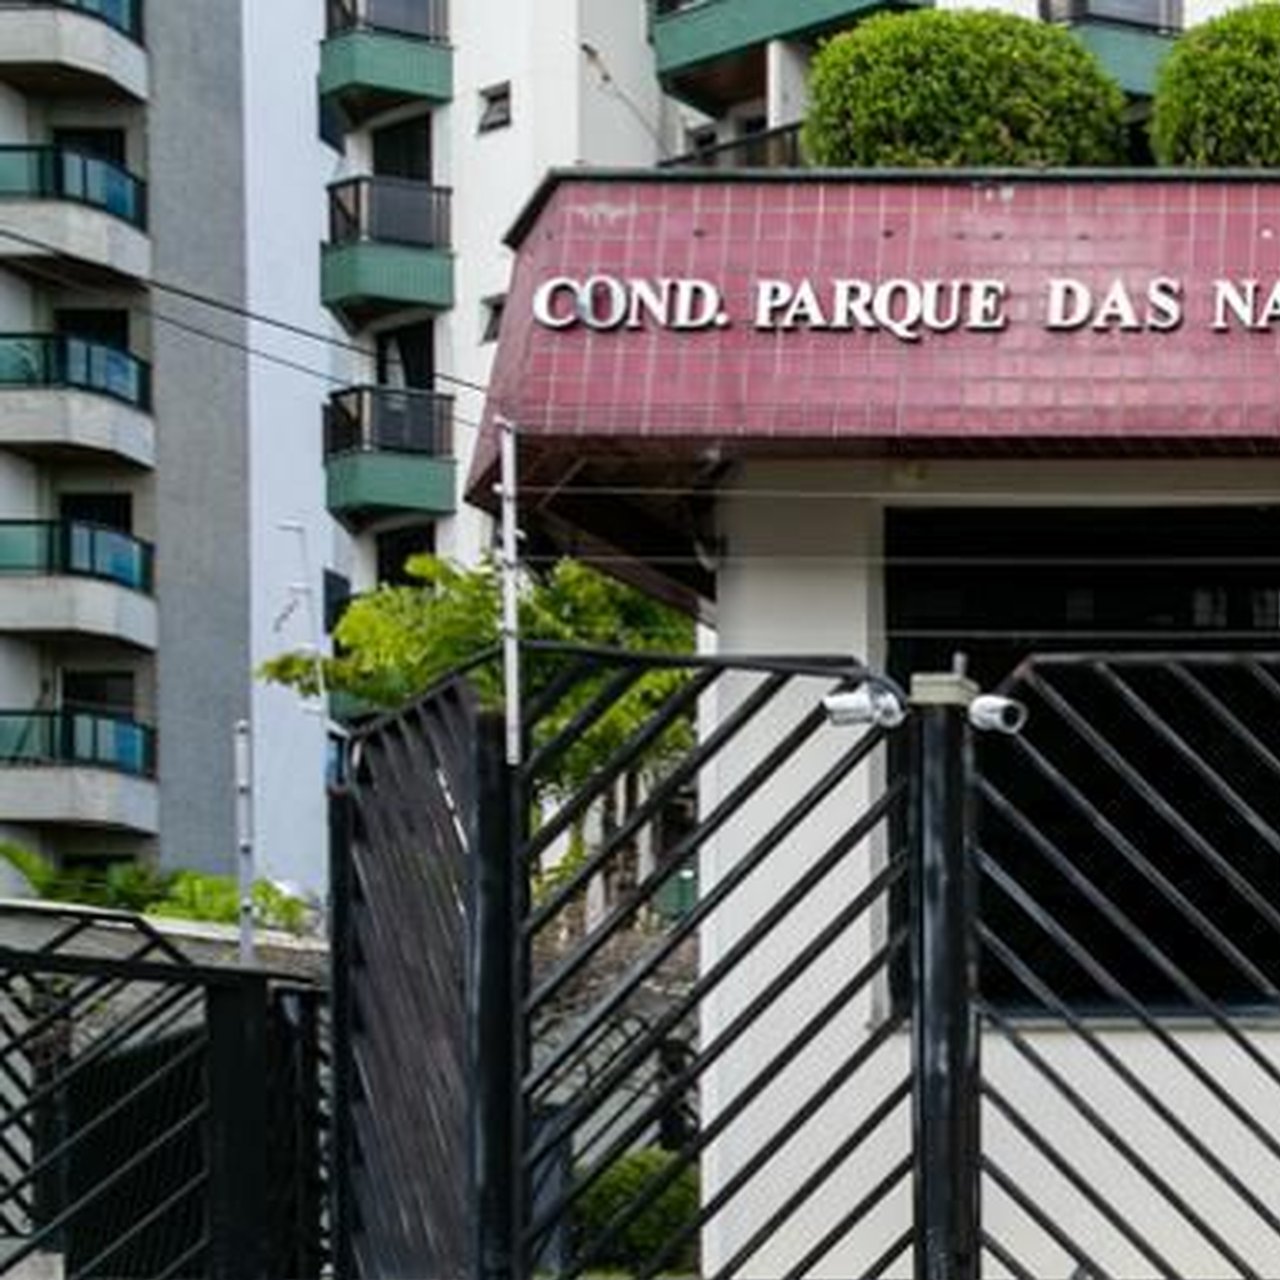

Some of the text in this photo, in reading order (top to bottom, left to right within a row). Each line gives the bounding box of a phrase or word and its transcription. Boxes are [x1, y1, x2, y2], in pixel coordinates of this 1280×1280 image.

[532, 275, 730, 329] COND.
[754, 278, 1006, 341] PARQUE
[1045, 277, 1182, 330] DAS
